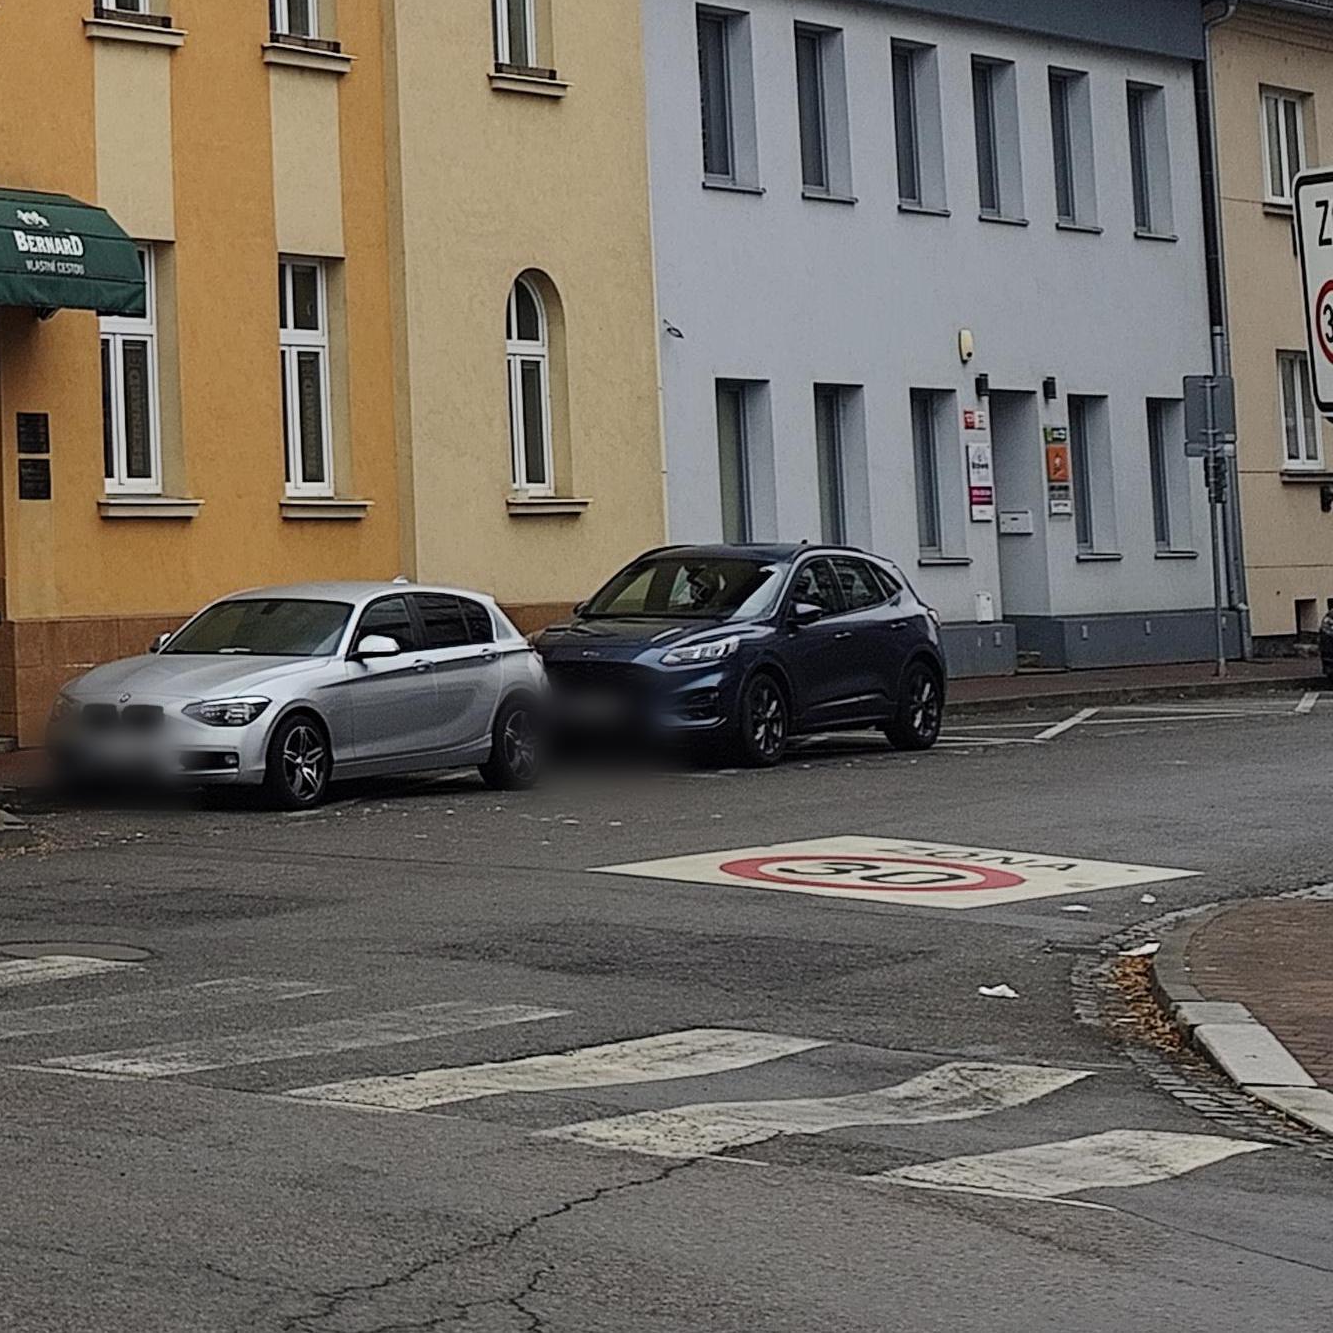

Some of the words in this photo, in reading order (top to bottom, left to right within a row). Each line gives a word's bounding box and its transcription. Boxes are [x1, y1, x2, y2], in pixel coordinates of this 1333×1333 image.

[1315, 200, 1333, 247] Z
[13, 230, 85, 257] BERNARD
[776, 861, 967, 885] 30
